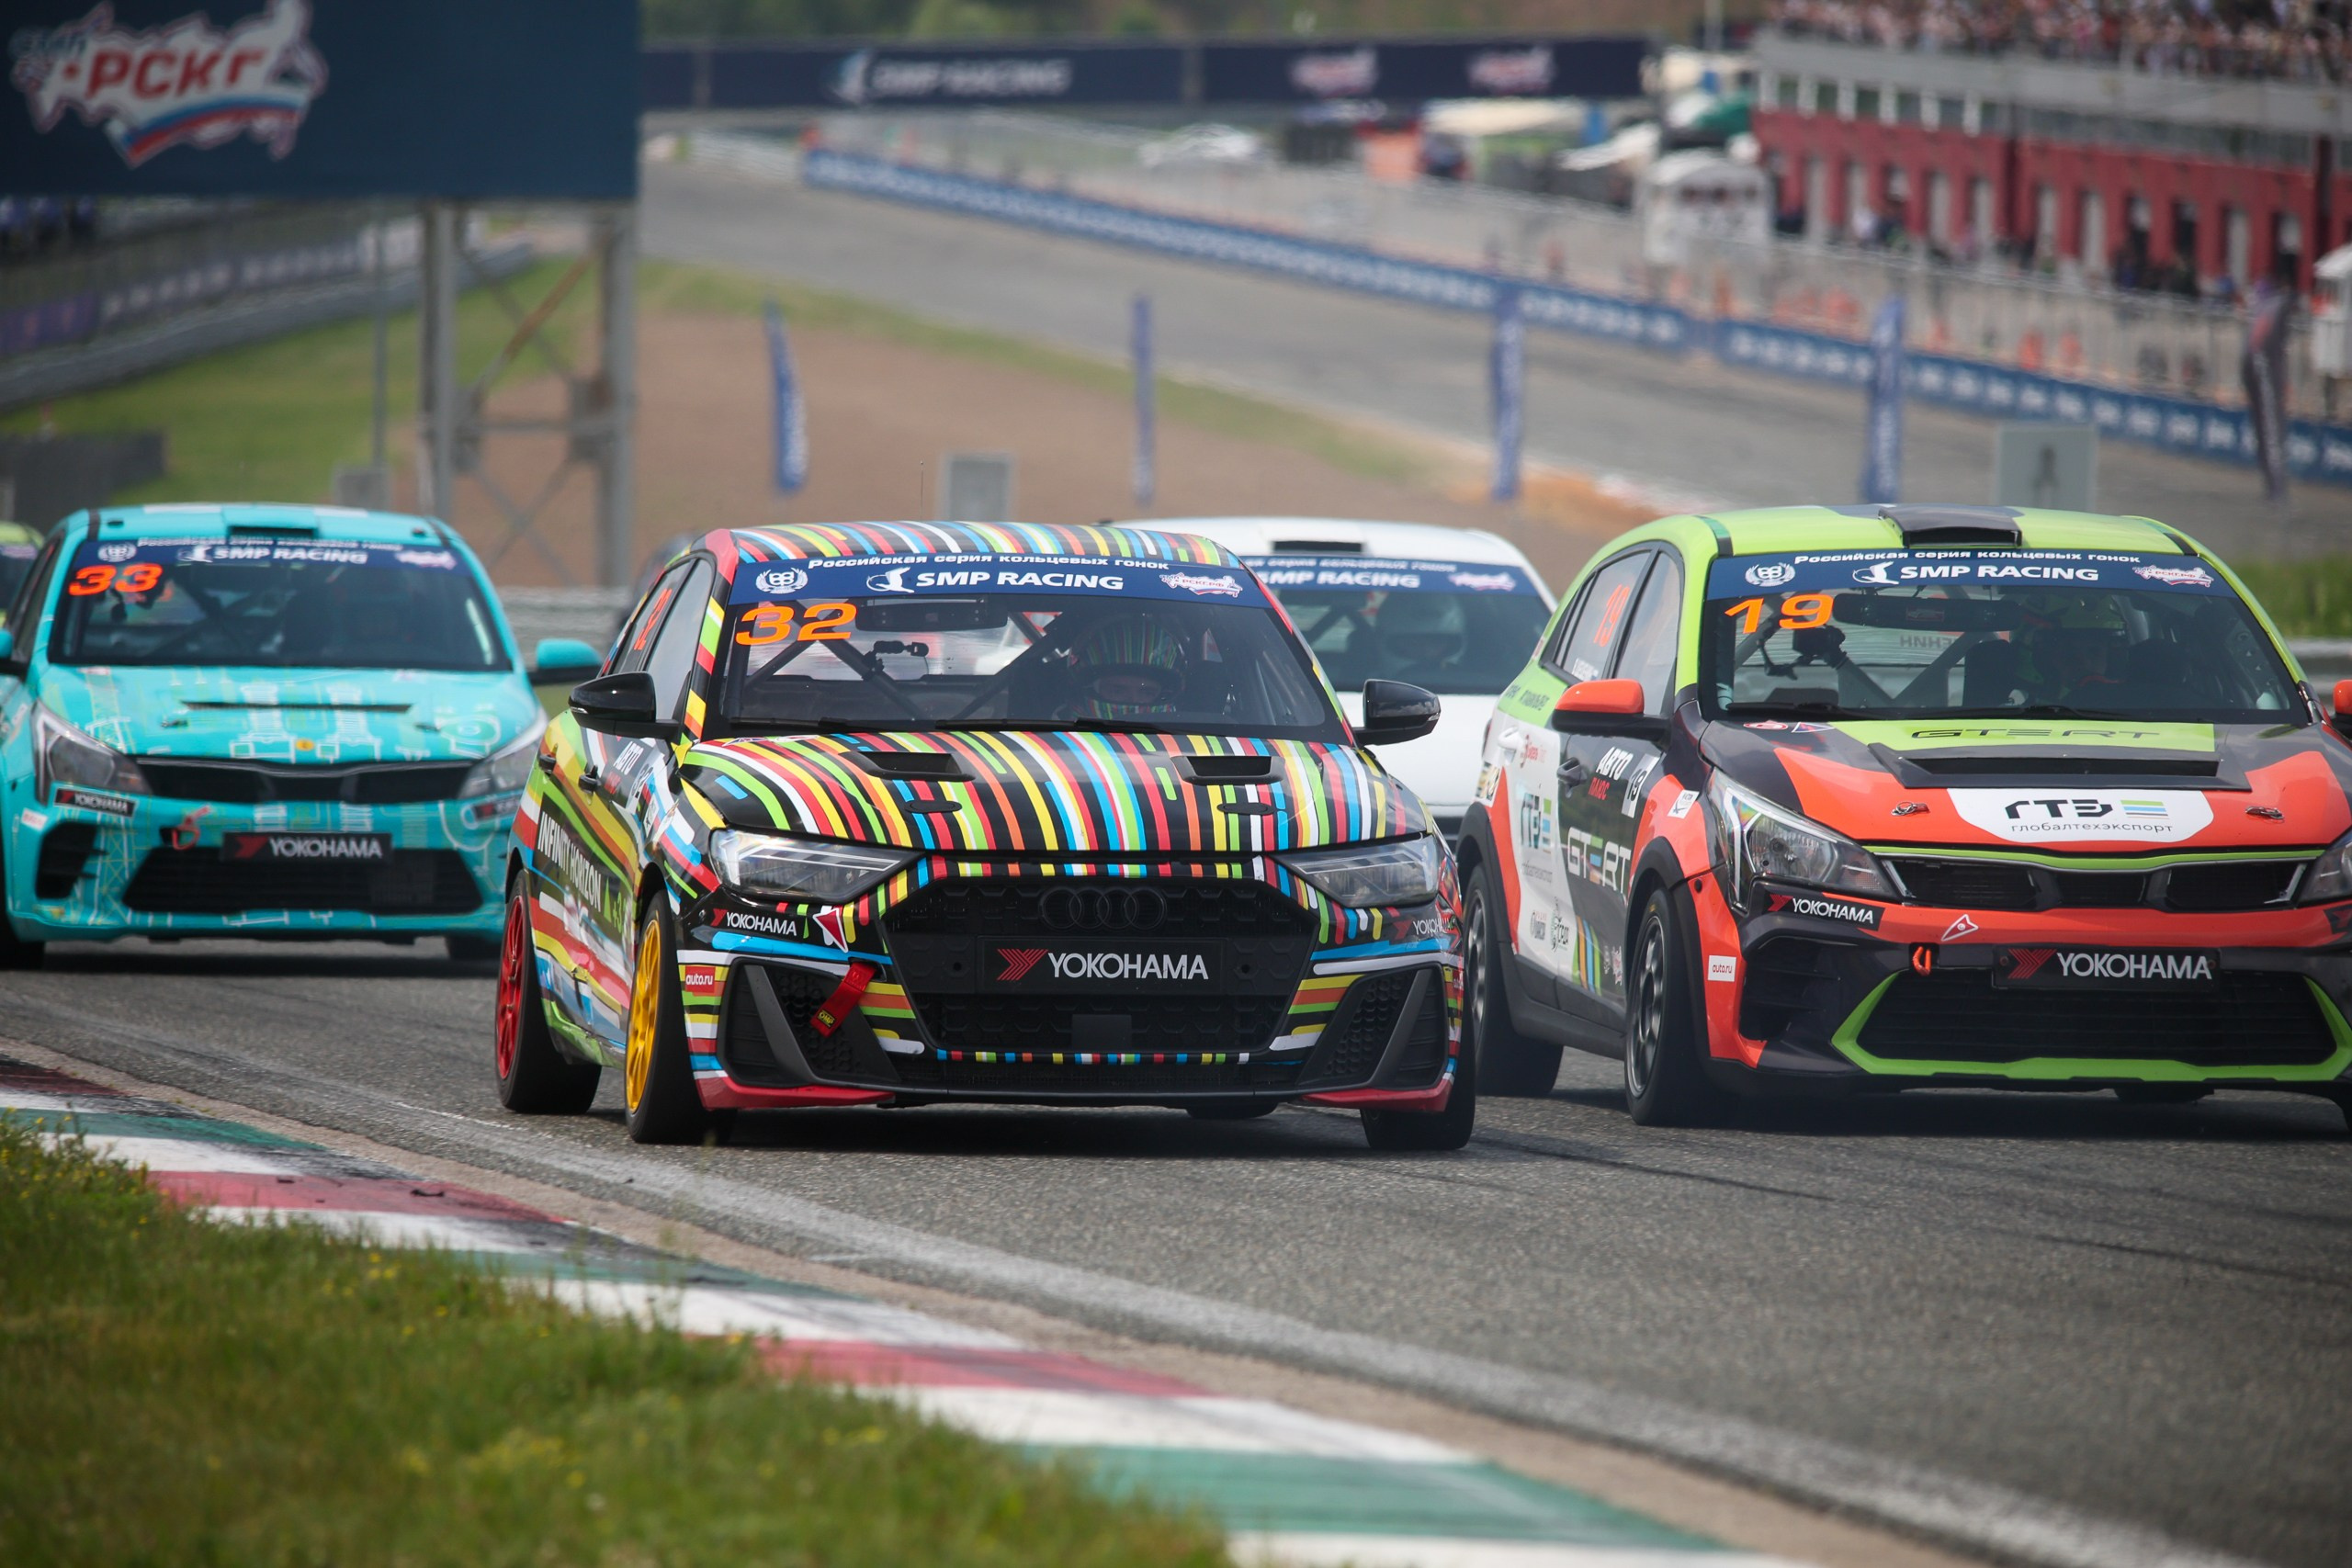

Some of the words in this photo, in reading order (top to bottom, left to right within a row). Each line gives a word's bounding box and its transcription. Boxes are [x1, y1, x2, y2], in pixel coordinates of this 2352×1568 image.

[214, 547, 270, 559] SMP
[274, 548, 368, 564] RACING
[808, 556, 927, 570] Российская
[933, 555, 992, 564] серия
[1000, 556, 1108, 566] кольцевых
[1114, 559, 1170, 570] гонок
[1794, 552, 1908, 565] Российская
[1915, 551, 1971, 560] серия
[1977, 551, 2082, 560] кольцевых
[2087, 553, 2141, 563] гонок
[69, 563, 163, 596] 33
[916, 571, 990, 586] SMP
[997, 571, 1124, 590] RACING
[1259, 571, 1315, 585] SMP
[1317, 571, 1420, 588] RACING
[1900, 565, 1971, 579] SMP
[1977, 565, 2099, 581] RACING
[1724, 592, 1835, 634] 19
[736, 603, 857, 646] 32
[1596, 746, 1634, 781] АВТО
[2011, 822, 2173, 833] глобалтехэкспорт
[268, 837, 382, 859] YOKOHAMA
[537, 811, 571, 875] INFINITY
[570, 843, 602, 913] HORIZON
[1792, 897, 1874, 924] YOKOHAMA
[727, 911, 797, 936] YOKOHAMA
[1047, 953, 1209, 979] YOKOHAMA
[1713, 964, 1733, 974] auto.ru
[2057, 953, 2212, 979] YOKOHAMA
[685, 974, 713, 986] auto.ru
